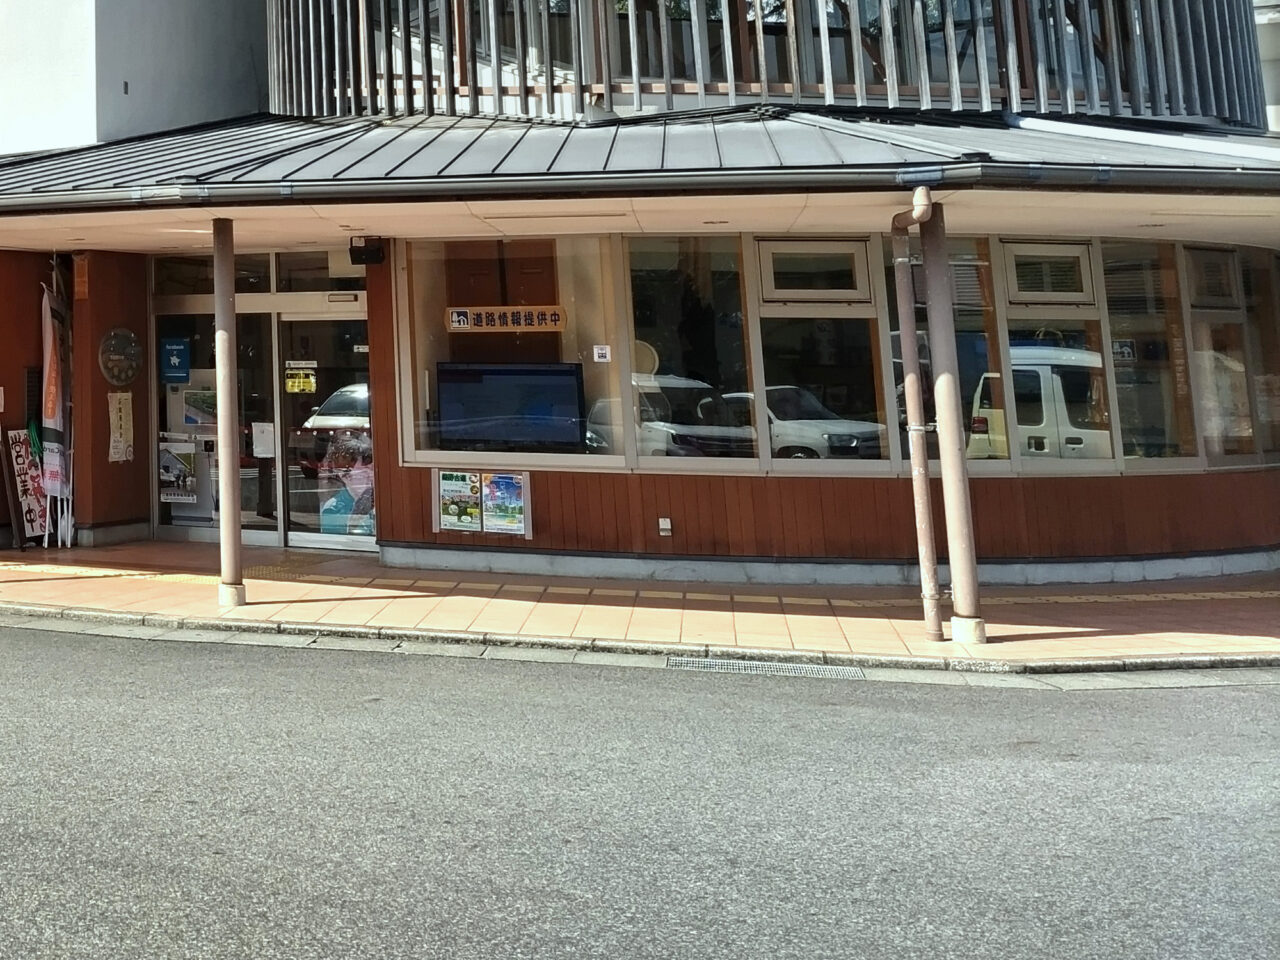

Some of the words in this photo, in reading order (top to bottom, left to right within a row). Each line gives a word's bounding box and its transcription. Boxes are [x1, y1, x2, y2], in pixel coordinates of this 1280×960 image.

[472, 311, 561, 327] 道路情報提供中
[10, 431, 37, 533] 営業中
